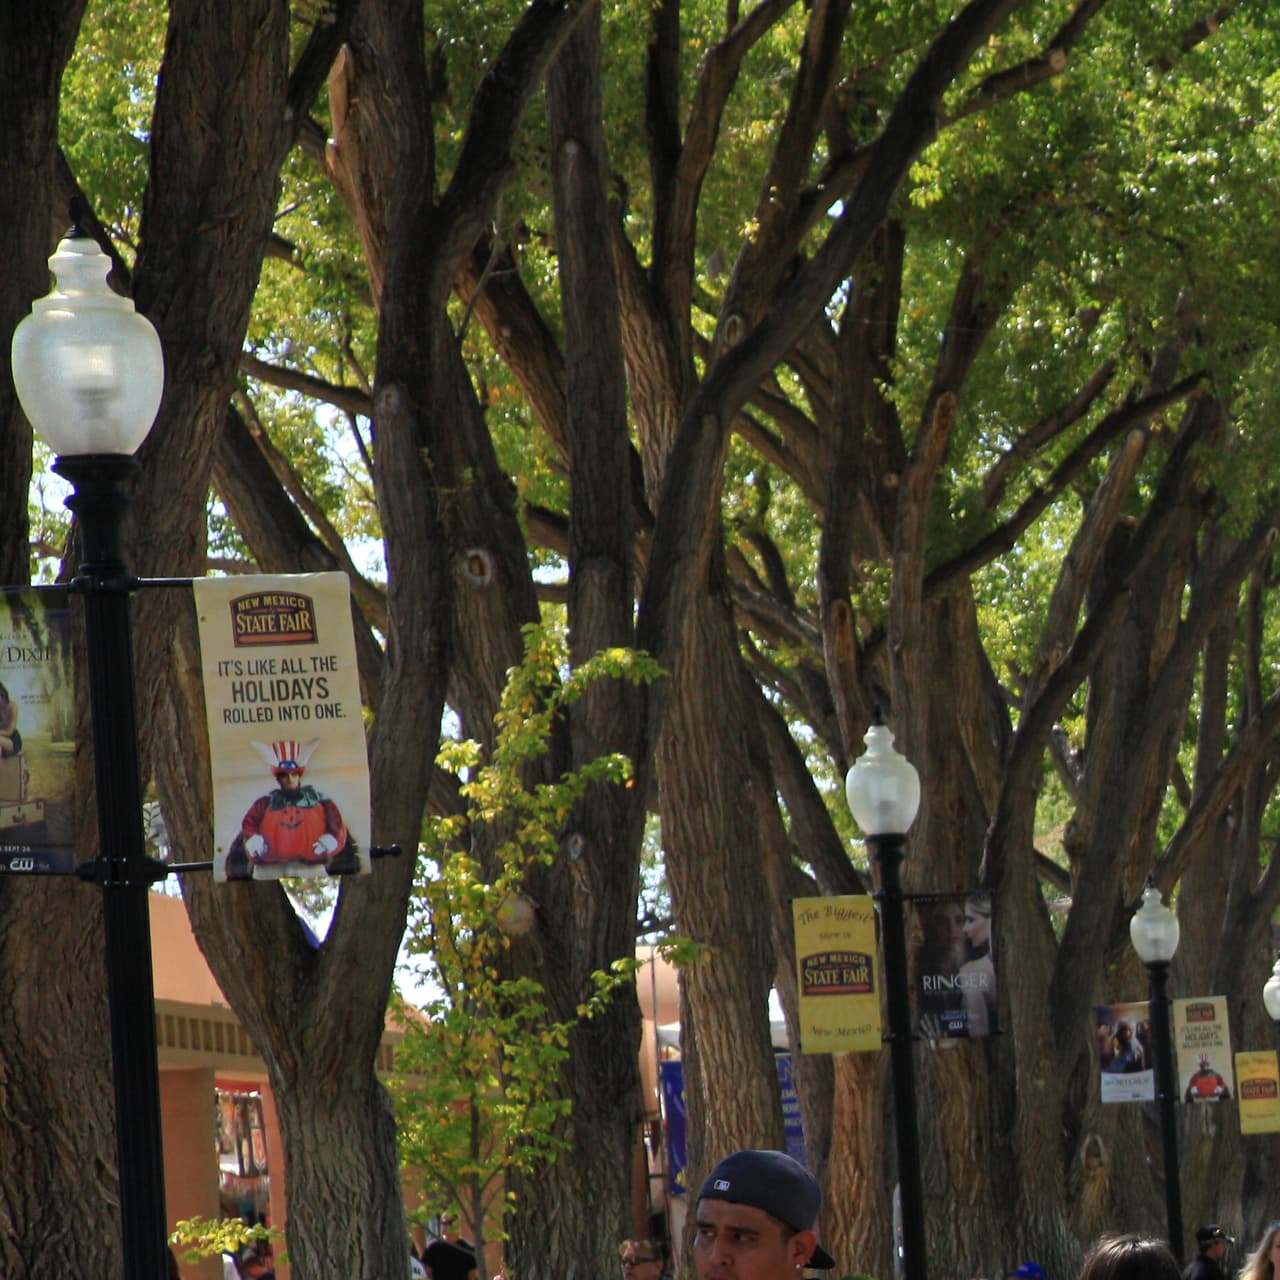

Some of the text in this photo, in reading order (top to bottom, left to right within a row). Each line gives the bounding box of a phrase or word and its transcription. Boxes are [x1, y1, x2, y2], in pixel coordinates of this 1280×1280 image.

[238, 595, 306, 612] NEW MEXICO
[236, 610, 312, 634] STATE FAIR
[218, 655, 339, 678] IT'S LIKE ALL THE
[231, 676, 330, 704] HOLIDAYS
[223, 703, 347, 725] ROLLED INTO ONE.
[807, 953, 867, 968] NEW MEXICO
[804, 966, 870, 986] STATE FAIR
[923, 974, 990, 991] RINGER
